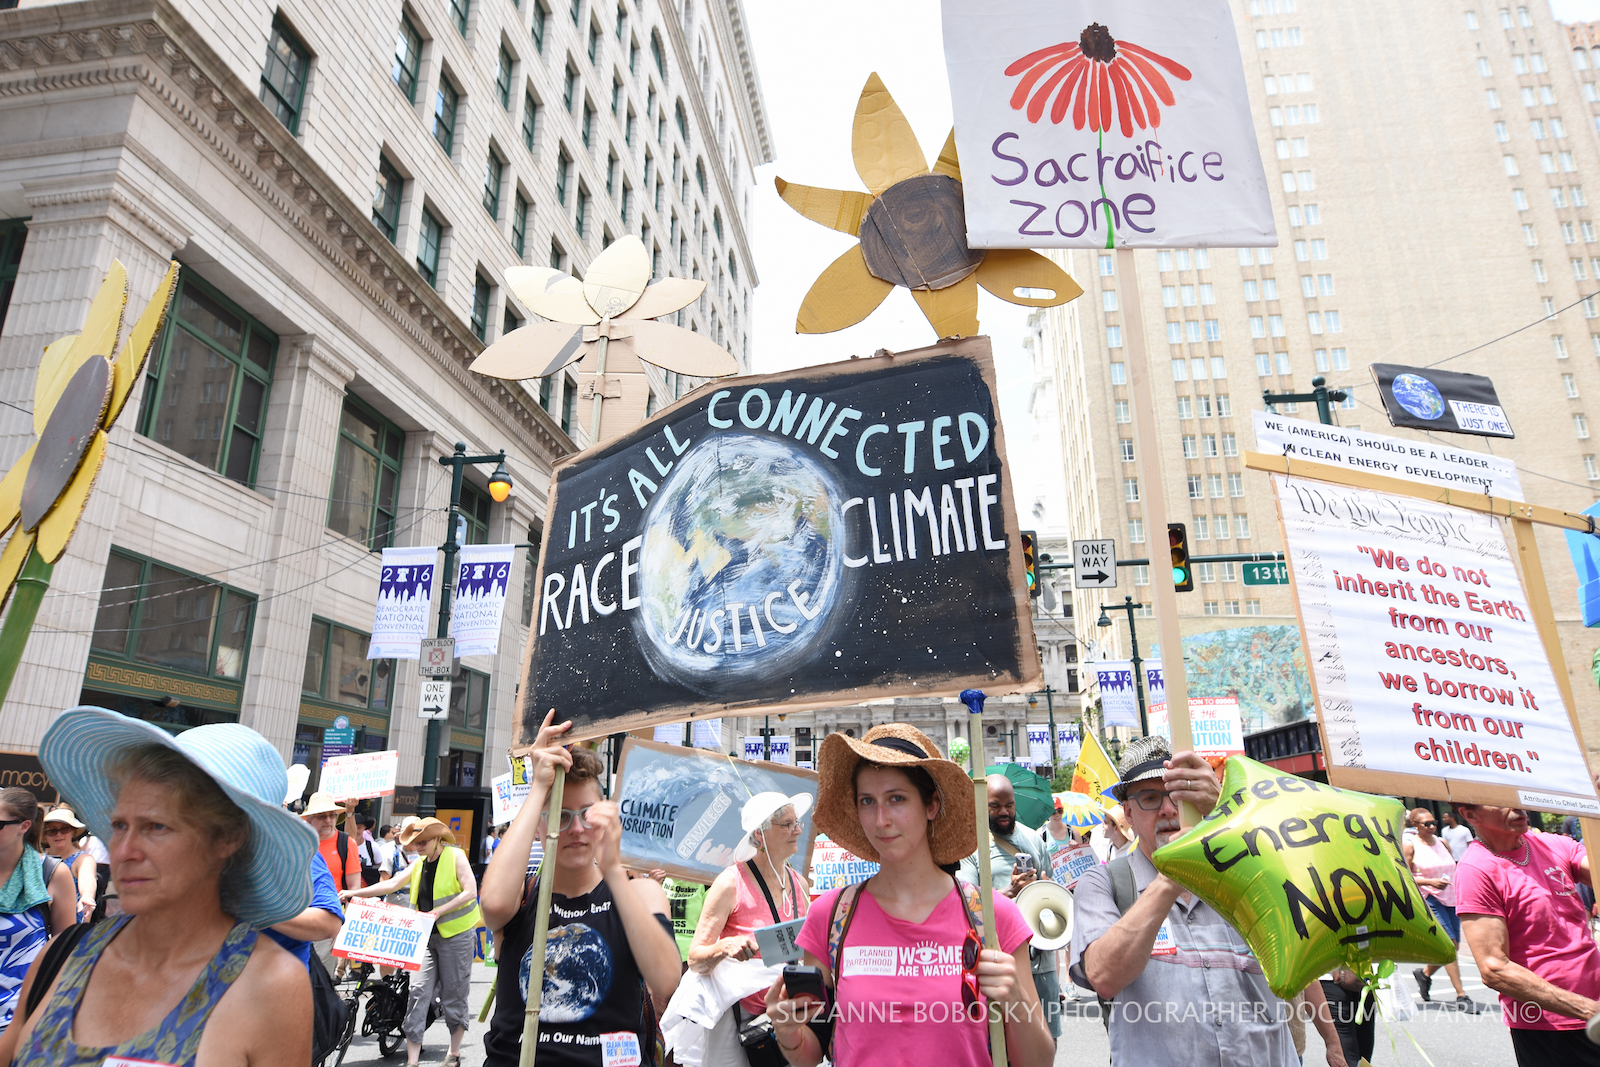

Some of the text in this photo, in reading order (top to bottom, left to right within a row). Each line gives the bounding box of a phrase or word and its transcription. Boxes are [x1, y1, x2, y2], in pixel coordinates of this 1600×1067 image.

[991, 131, 1225, 187] Sacraifice
[1010, 193, 1156, 238] zone
[1453, 402, 1500, 417] THERE IS
[707, 388, 990, 477] CONNECTED
[1461, 417, 1511, 433] JUST ONE!
[1264, 420, 1489, 470] WE (AMERICA) SHOULD BE A LEADER
[1282, 443, 1296, 455] IN
[1300, 446, 1341, 463] CLEAN
[1349, 456, 1399, 472] ENERGY
[1405, 466, 1493, 487] DEVELOPMENT
[567, 424, 691, 549] IT'S ALL
[1291, 483, 1340, 520] We
[1343, 492, 1383, 528] the
[1381, 498, 1471, 547] People
[540, 473, 1006, 637] RACE CLIMATE
[1081, 544, 1107, 555] ONE
[1081, 557, 1108, 568] WAY
[1357, 545, 1491, 588] "We do not
[1333, 570, 1417, 602] inherit
[1420, 582, 1460, 609] the
[1464, 591, 1526, 622] Earth
[376, 605, 426, 613] DEMOCRATIC
[376, 613, 424, 622] NATIONAL
[453, 610, 498, 620] NATIONAL
[664, 579, 821, 655] JUSTICE
[453, 619, 497, 629] CONVENTION
[1389, 607, 1493, 643] from our
[1385, 641, 1517, 680] ancestors,
[436, 666, 450, 674] BOX
[426, 684, 445, 693] ONE
[1378, 671, 1539, 710] we borrow it
[424, 694, 445, 702] WAY
[1412, 702, 1524, 740] from our
[1414, 737, 1540, 773] children."
[327, 774, 355, 785] CLEAN
[357, 769, 390, 781] ENERGY
[621, 799, 679, 822] CLIMATE
[1524, 795, 1554, 805] Attributed
[1562, 799, 1578, 807] Chief
[1578, 802, 1599, 811] Seattle
[678, 793, 732, 858] PRIVILEGE
[1200, 812, 1408, 873] Energy
[822, 852, 835, 862] WE
[816, 861, 881, 875] CLEAN ENERG
[1053, 854, 1094, 879] LEAN ENERGY
[675, 885, 699, 894] Quaker
[590, 901, 612, 914] End?
[1282, 863, 1437, 941] NOW!
[360, 910, 415, 928] WE ARE THE
[348, 919, 422, 943] CLEAN ENERGY
[775, 930, 786, 944] FOR
[347, 952, 405, 968] CleanEnergyMarch.org
[859, 949, 893, 957] PLANNED
[846, 958, 893, 968] PARENTHOOD
[897, 965, 962, 977] ARE WATCHI
[539, 1032, 550, 1043] In
[553, 1032, 573, 1044] Our
